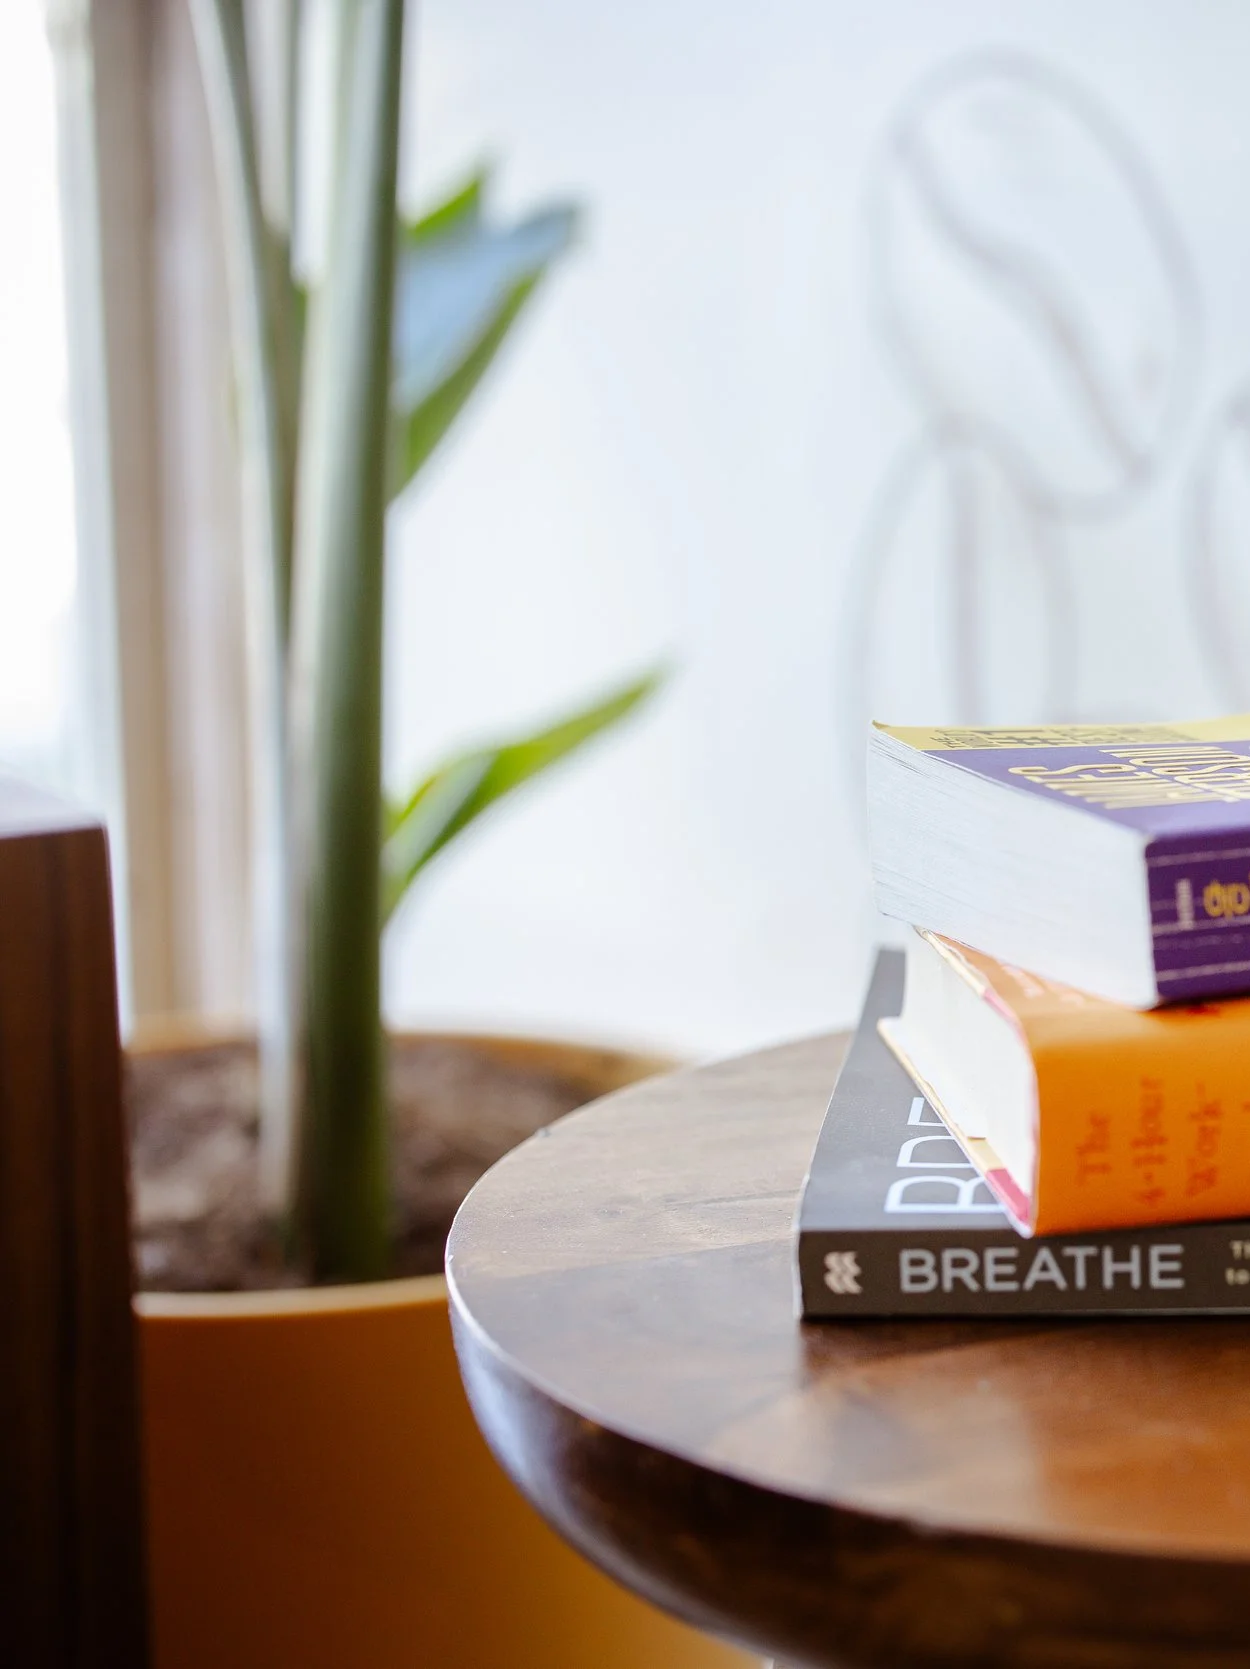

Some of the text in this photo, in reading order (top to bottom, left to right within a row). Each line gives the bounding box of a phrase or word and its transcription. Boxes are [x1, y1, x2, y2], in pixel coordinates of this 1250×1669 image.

[1075, 1112, 1111, 1187] The
[901, 1244, 1184, 1293] BREATHE
[1225, 1267, 1250, 1285] to
